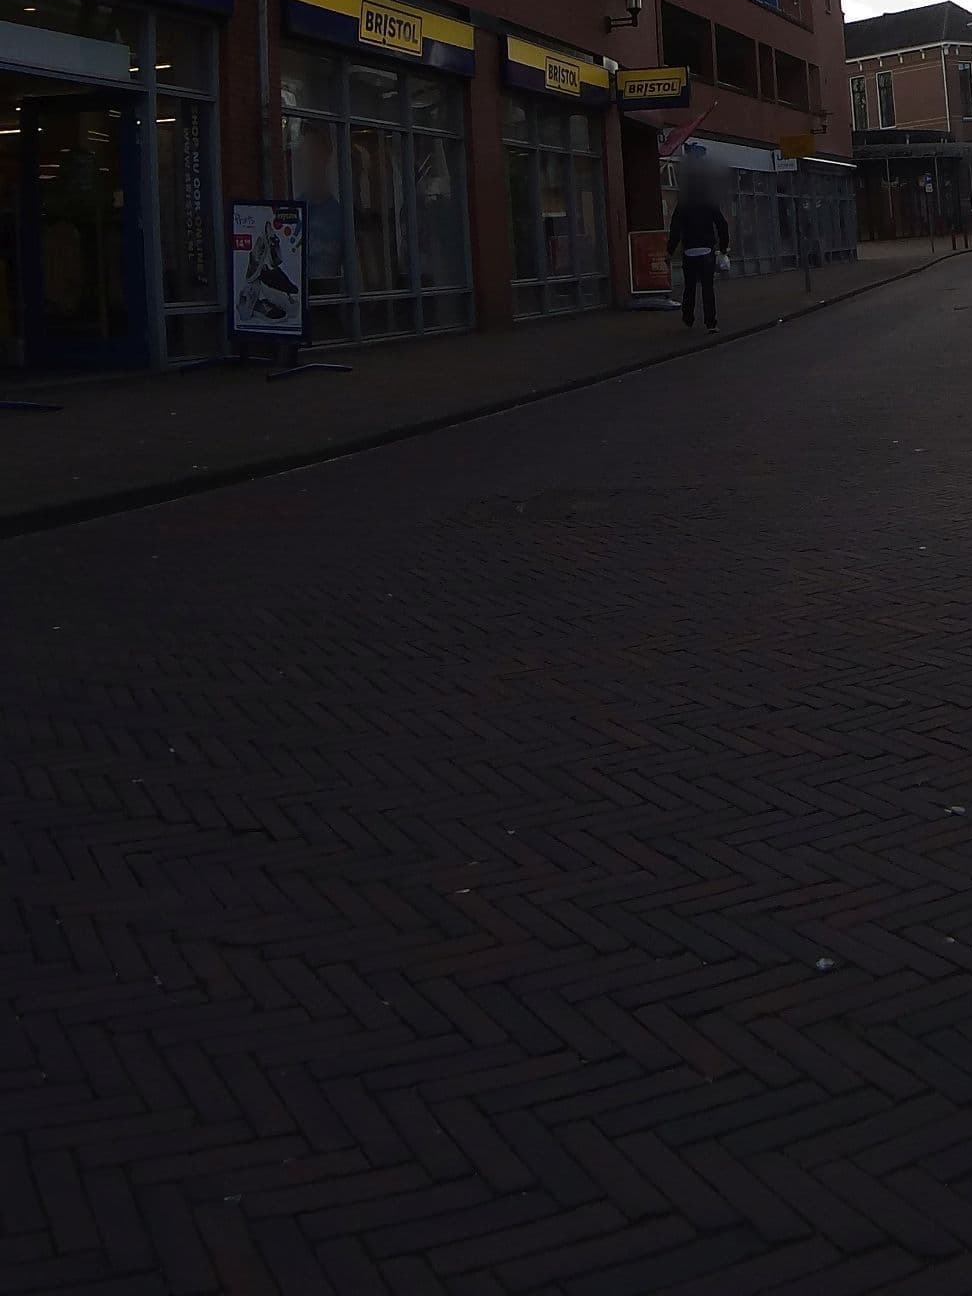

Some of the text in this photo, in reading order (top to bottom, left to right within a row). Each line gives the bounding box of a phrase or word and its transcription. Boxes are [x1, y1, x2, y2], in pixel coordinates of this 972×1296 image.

[365, 10, 418, 45] BRISTOL
[548, 63, 578, 87] BRISTOL
[629, 80, 678, 96] BRISTOL
